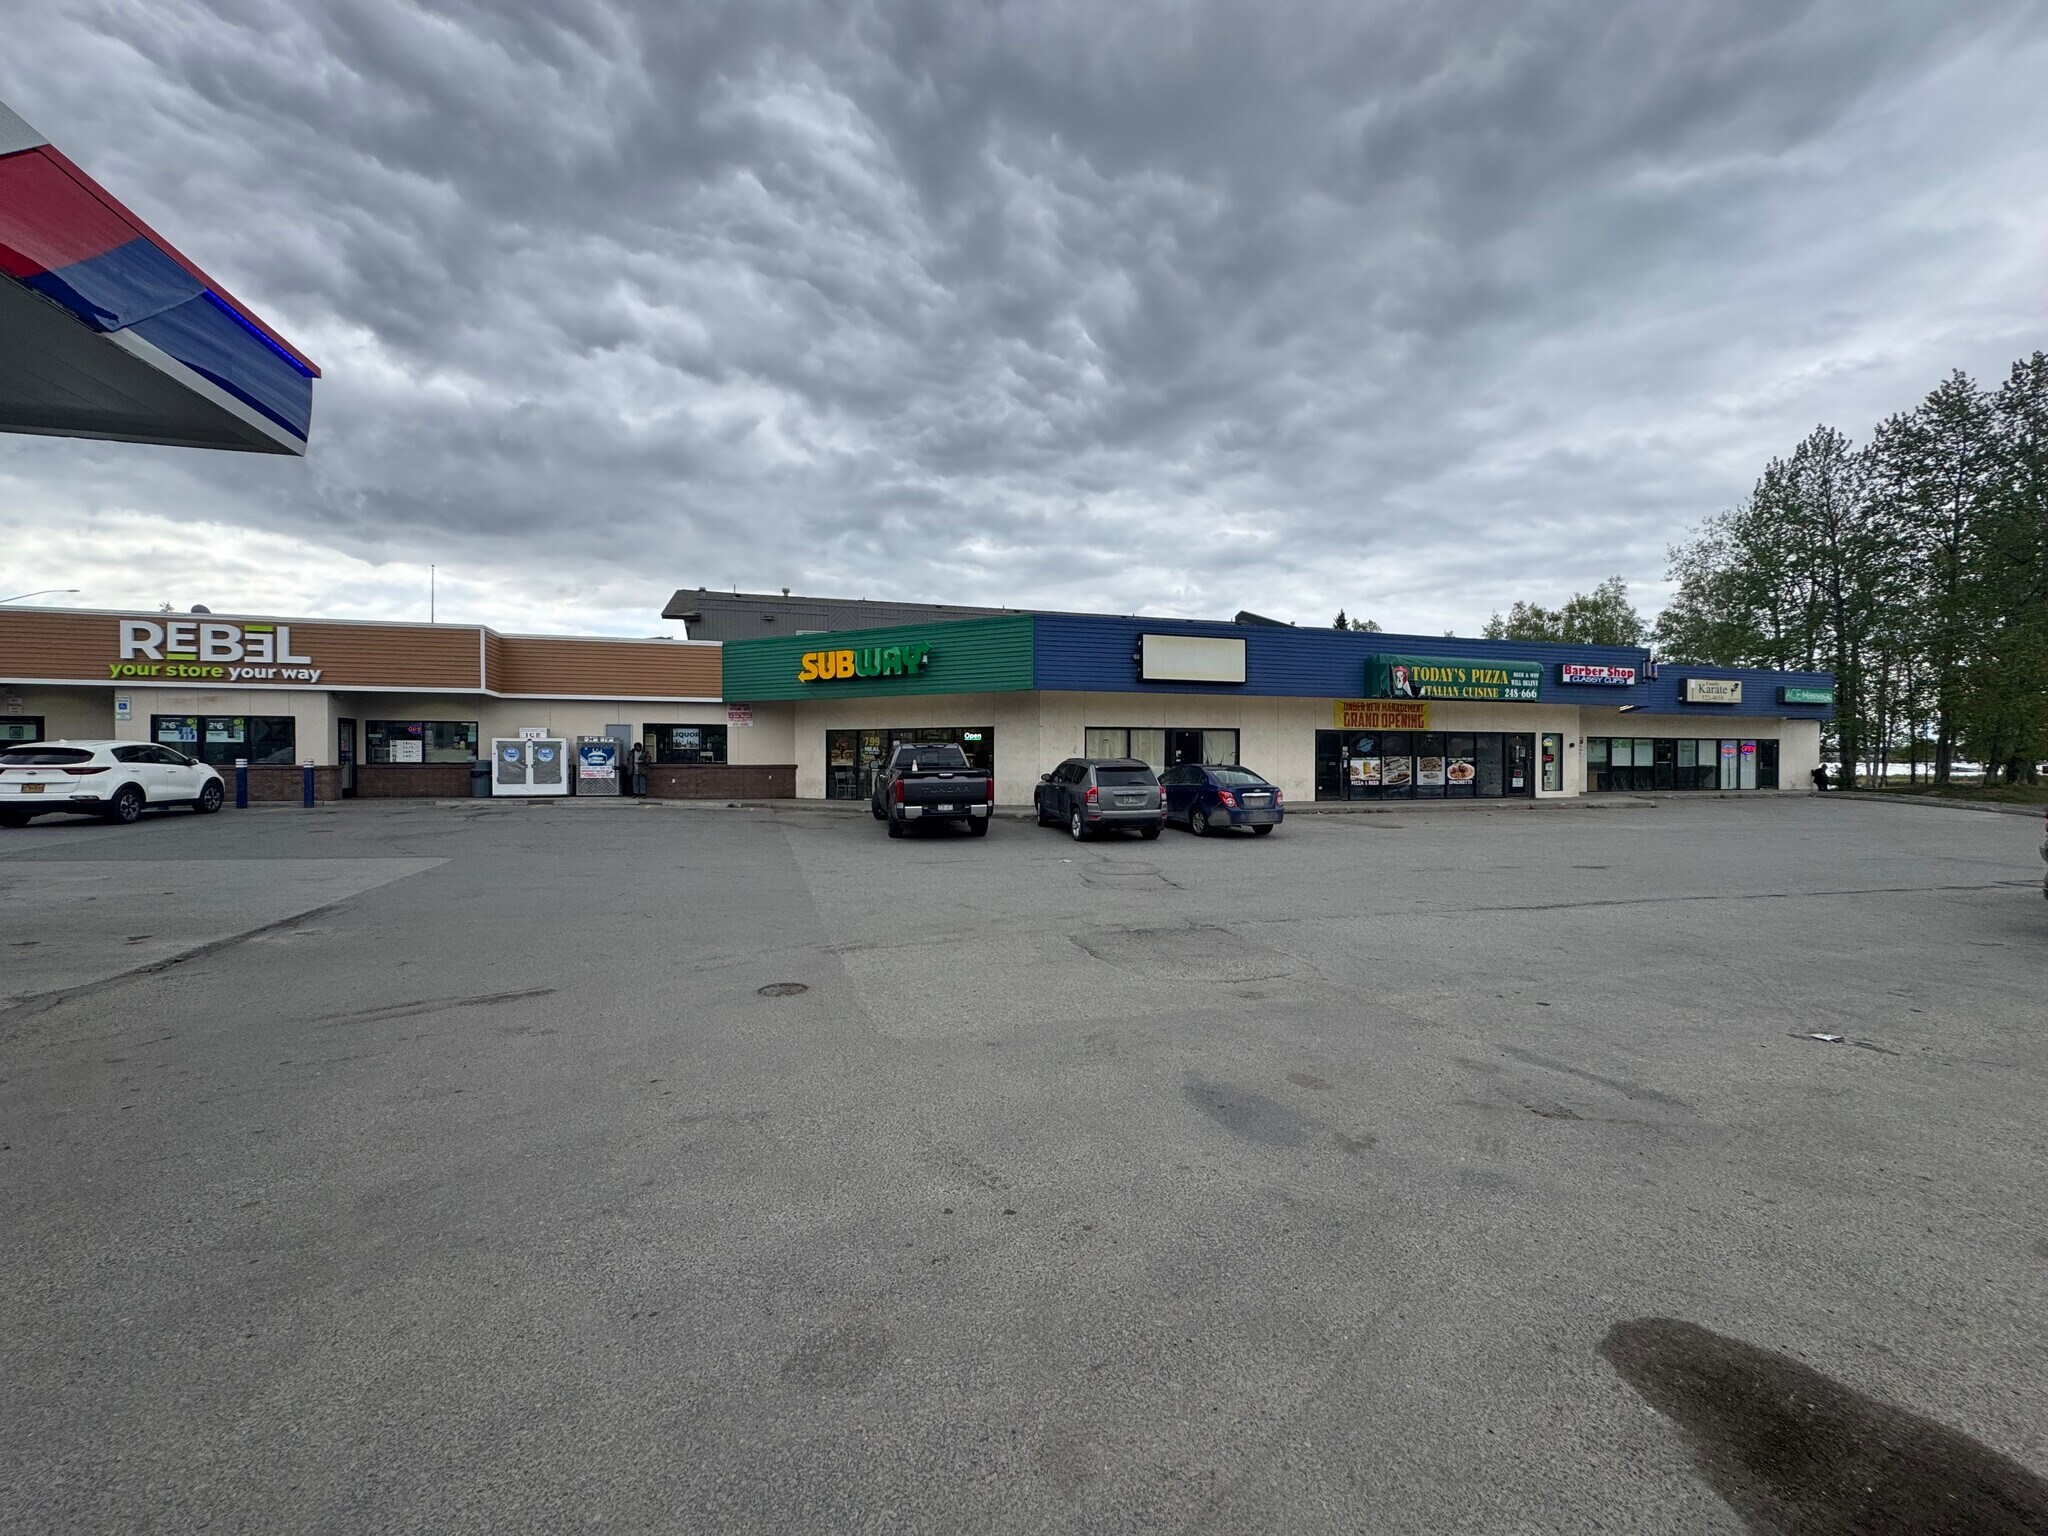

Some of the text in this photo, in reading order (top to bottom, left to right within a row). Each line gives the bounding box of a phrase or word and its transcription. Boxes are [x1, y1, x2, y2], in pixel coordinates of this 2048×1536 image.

[119, 619, 312, 664] REBEL
[797, 640, 932, 683] SUBWAY
[109, 664, 322, 683] your store your way
[1412, 666, 1508, 684] TODAY'S PIZZA
[1564, 664, 1634, 679] Barber Shop
[1423, 686, 1498, 698] ITALIAN CUISINE
[1504, 688, 1538, 699] 248-666
[1698, 684, 1727, 695] Karate
[1786, 688, 1833, 700] ACE Massage
[1344, 702, 1424, 713] UNDER NEW MANAGEMENT
[1344, 712, 1424, 728] GRAND OPENING
[964, 732, 982, 741] Open
